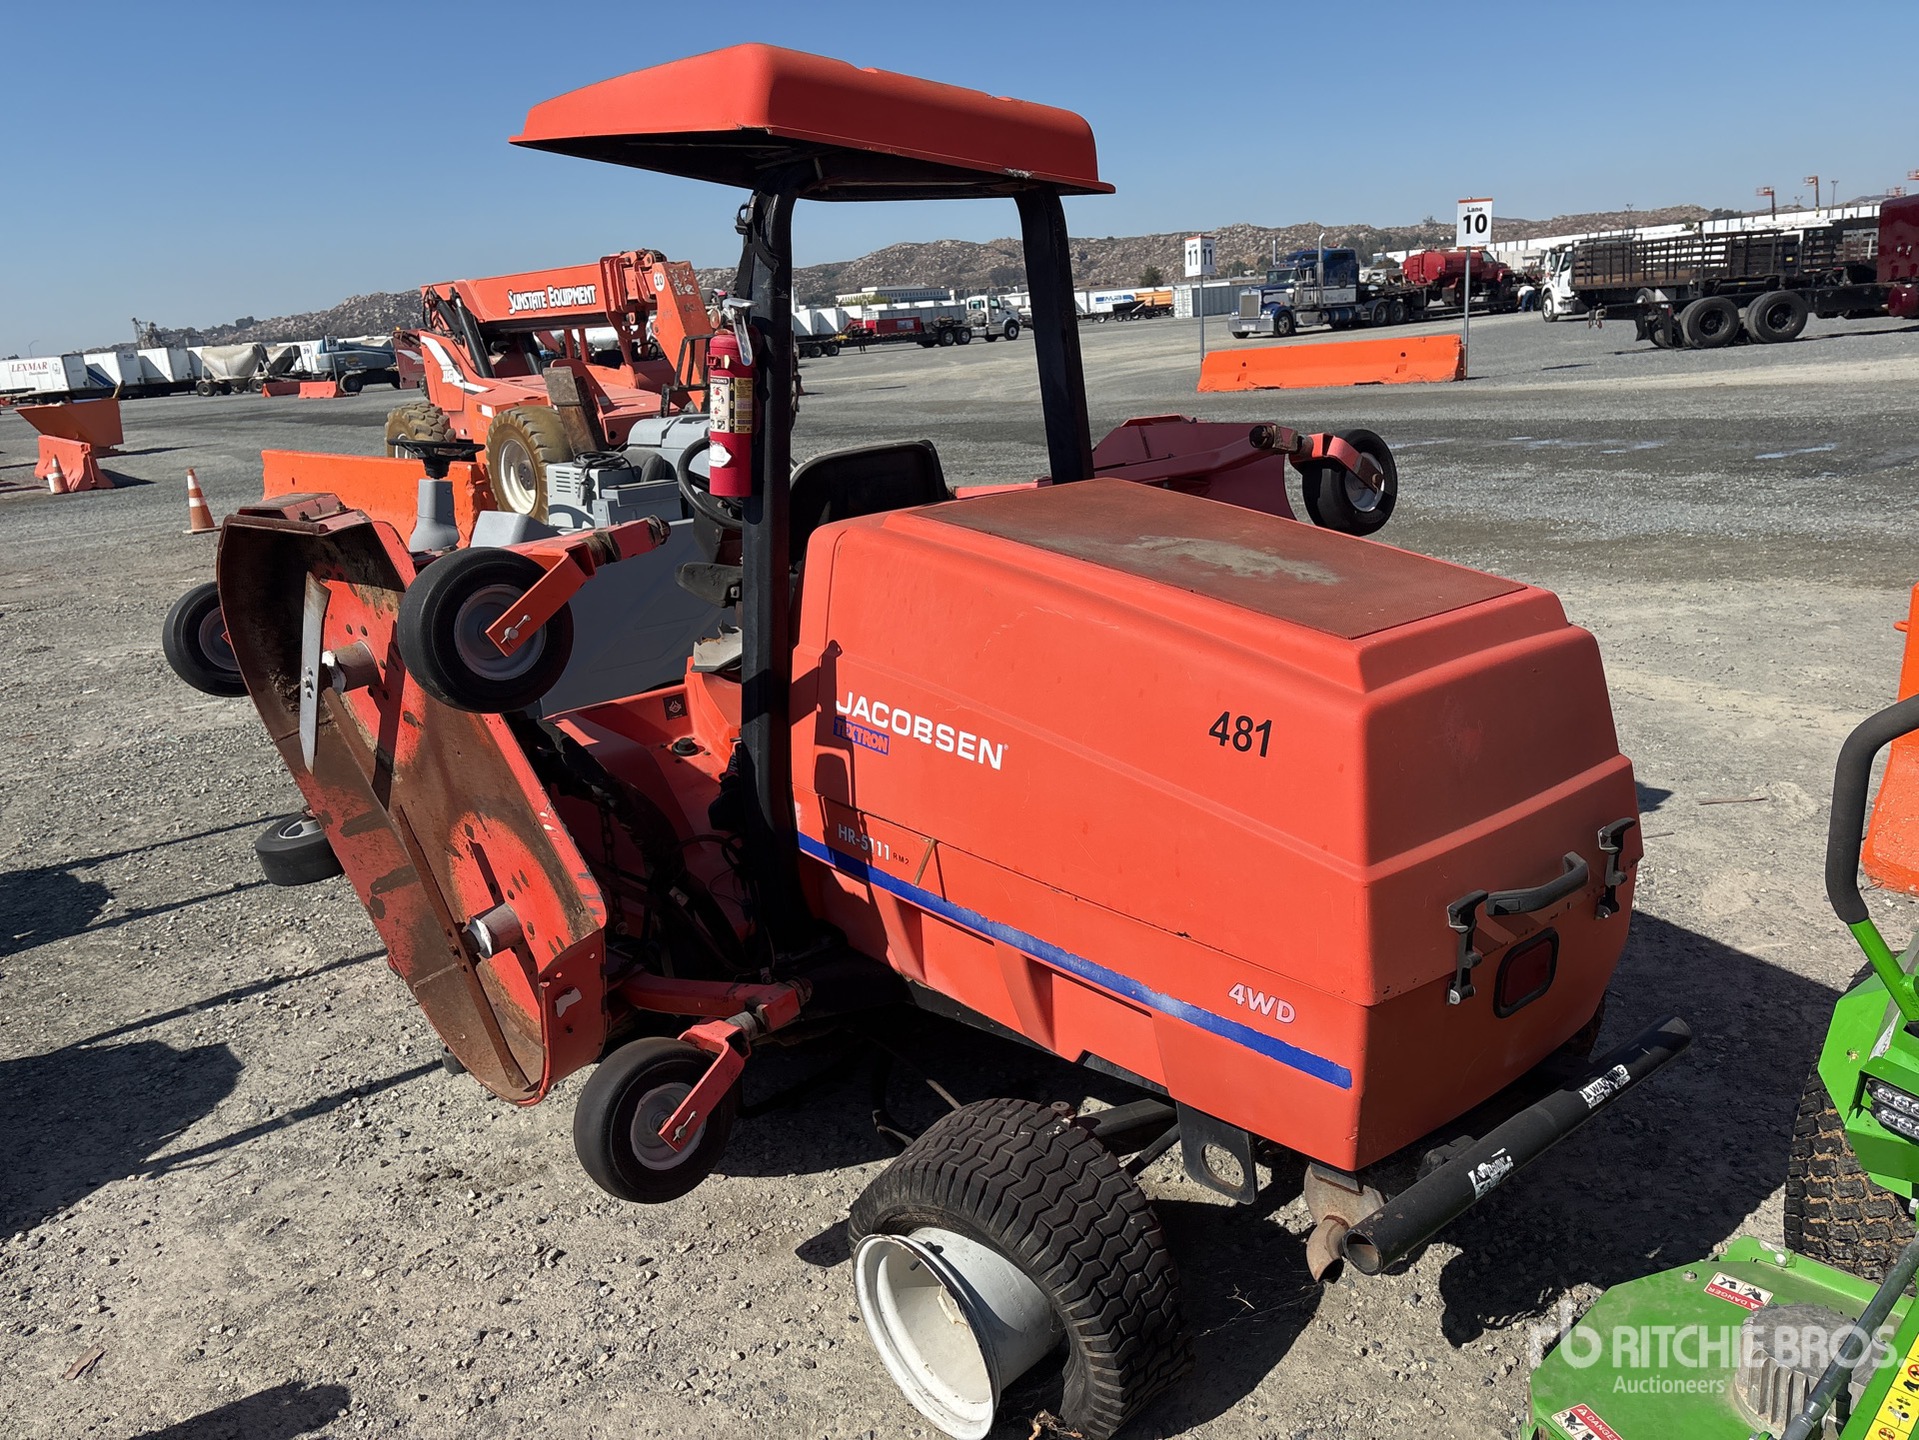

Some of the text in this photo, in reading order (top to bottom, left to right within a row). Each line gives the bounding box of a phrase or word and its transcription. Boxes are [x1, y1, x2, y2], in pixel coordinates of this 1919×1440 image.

[1463, 213, 1488, 234] 10
[1188, 249, 1198, 266] 11
[1203, 248, 1213, 265] 11
[655, 275, 664, 286] 10
[547, 284, 596, 308] EQUIPMENT
[11, 362, 48, 372] LEXMAR
[730, 382, 735, 391] A
[834, 718, 888, 753] TEXTRON
[835, 691, 1003, 771] JACOBSEN
[1209, 711, 1272, 757] 481
[838, 823, 890, 860] HR-5111
[1228, 982, 1296, 1023] 4WD
[1707, 1286, 1749, 1306] DANGER
[1586, 1415, 1619, 1440] DANGE
